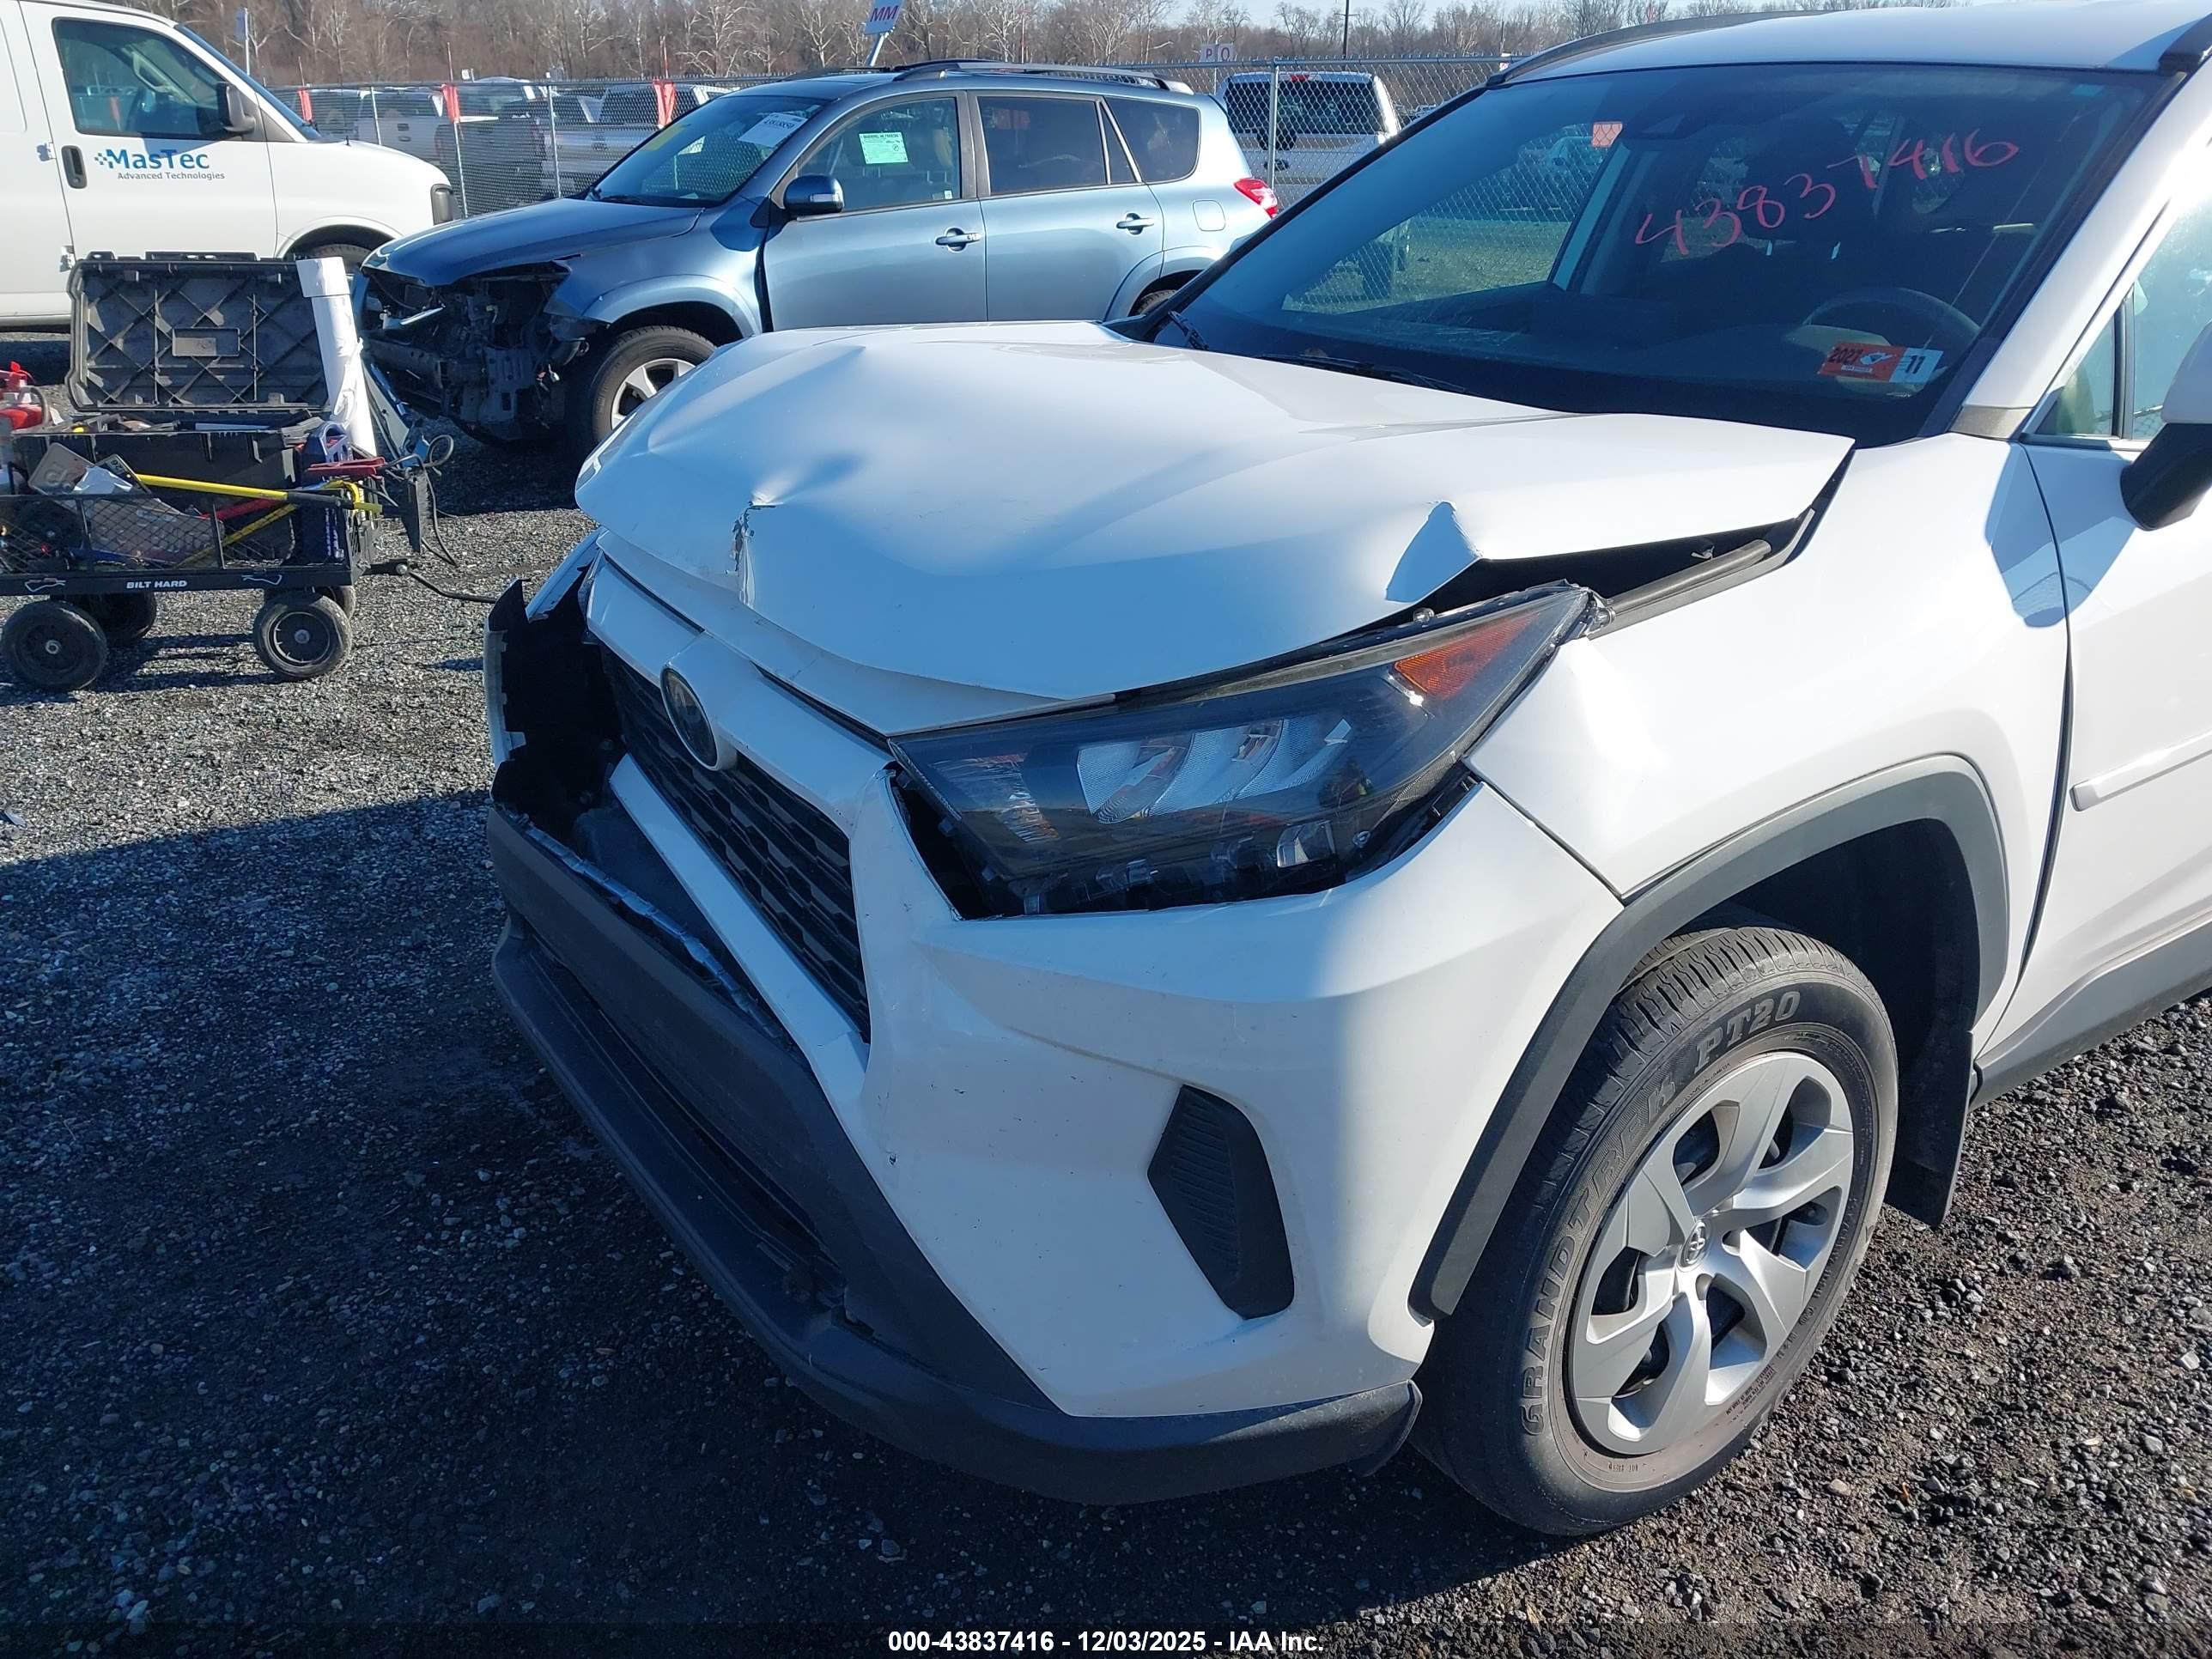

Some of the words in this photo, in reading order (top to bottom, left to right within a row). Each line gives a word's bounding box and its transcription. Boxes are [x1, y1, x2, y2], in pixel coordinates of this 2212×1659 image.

[870, 5, 899, 22] MM
[1206, 48, 1212, 59] P
[106, 149, 210, 169] MasTec
[166, 172, 226, 181] Technologies
[1905, 355, 1926, 374] 11
[154, 580, 187, 588] HARD
[1693, 991, 1801, 1074] PT20
